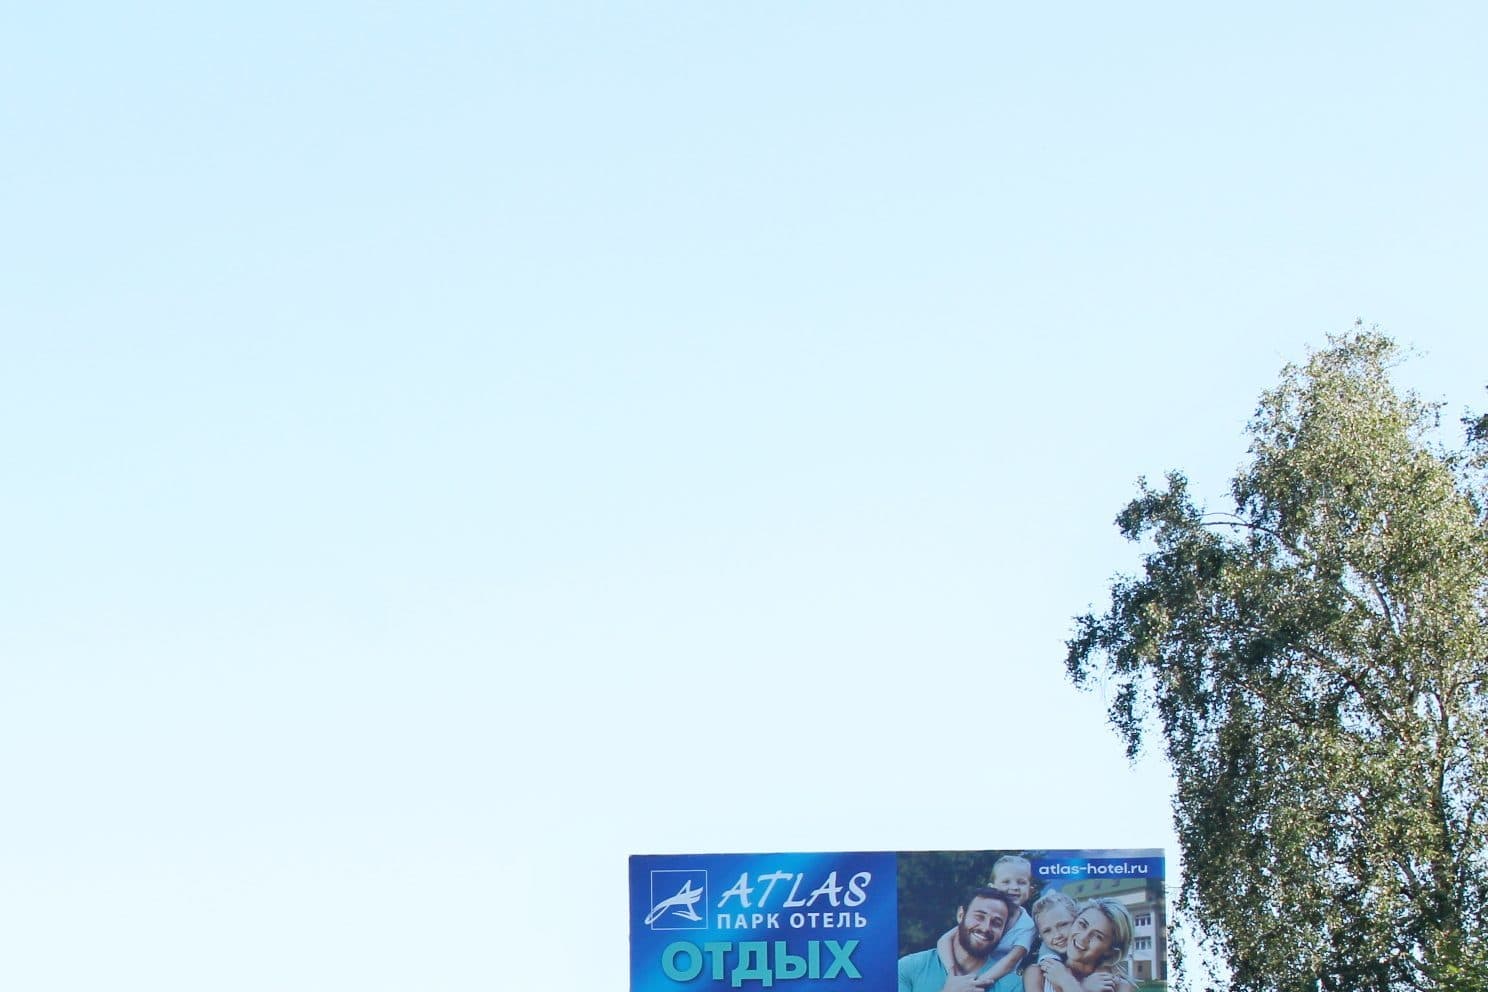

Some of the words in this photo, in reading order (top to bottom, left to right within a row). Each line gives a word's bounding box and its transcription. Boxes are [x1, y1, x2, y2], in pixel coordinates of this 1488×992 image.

[1038, 862, 1149, 875] atlas-hotel.ru
[717, 870, 872, 908] ATLAS
[717, 912, 780, 929] ПАРК
[789, 911, 868, 929] ОТЕЛЬ
[661, 939, 862, 987] ОТДЫХ
